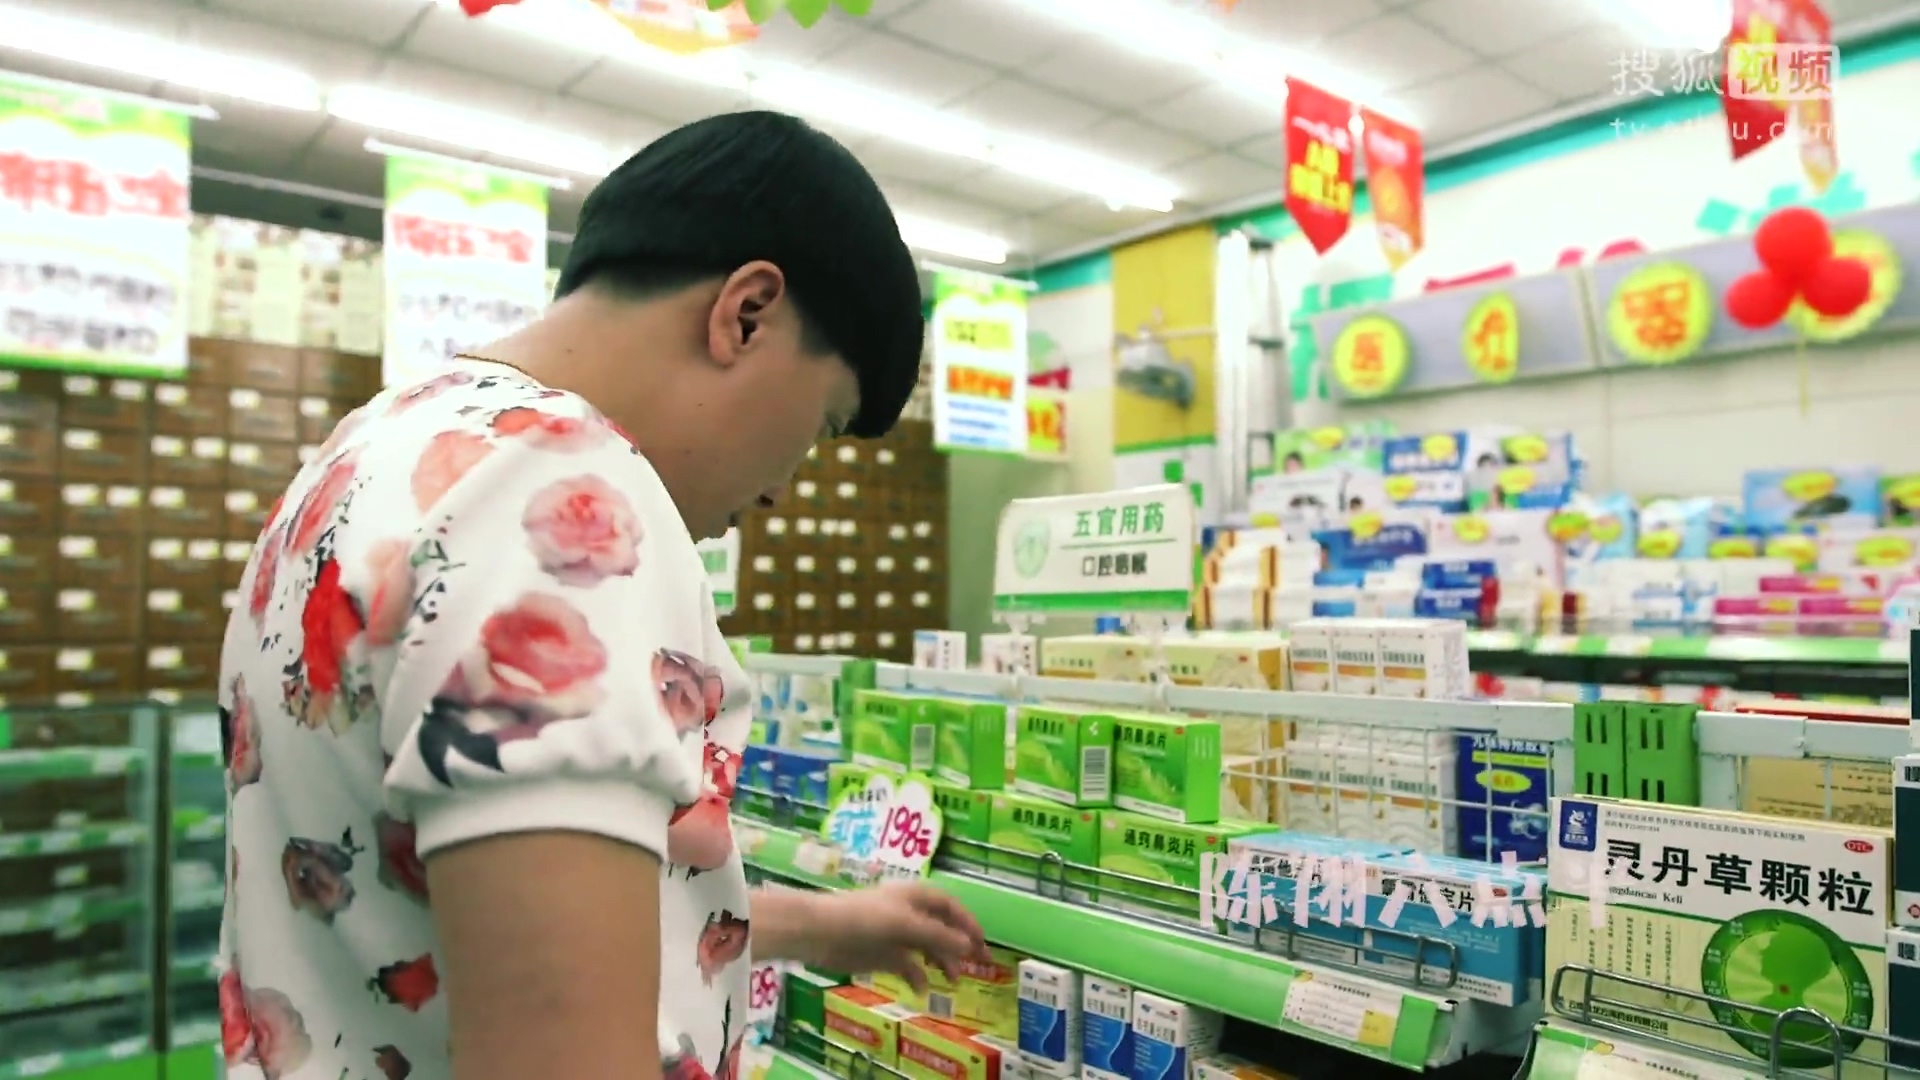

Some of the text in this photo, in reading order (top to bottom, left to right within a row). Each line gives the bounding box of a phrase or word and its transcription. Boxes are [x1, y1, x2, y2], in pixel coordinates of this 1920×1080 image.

[1072, 502, 1165, 537] 五官用药
[1124, 828, 1196, 857] 通窍鼻炎片
[1845, 841, 1873, 853] OTC
[1604, 839, 1874, 916] 灵丹草颗粒
[1663, 892, 1684, 905] Keli
